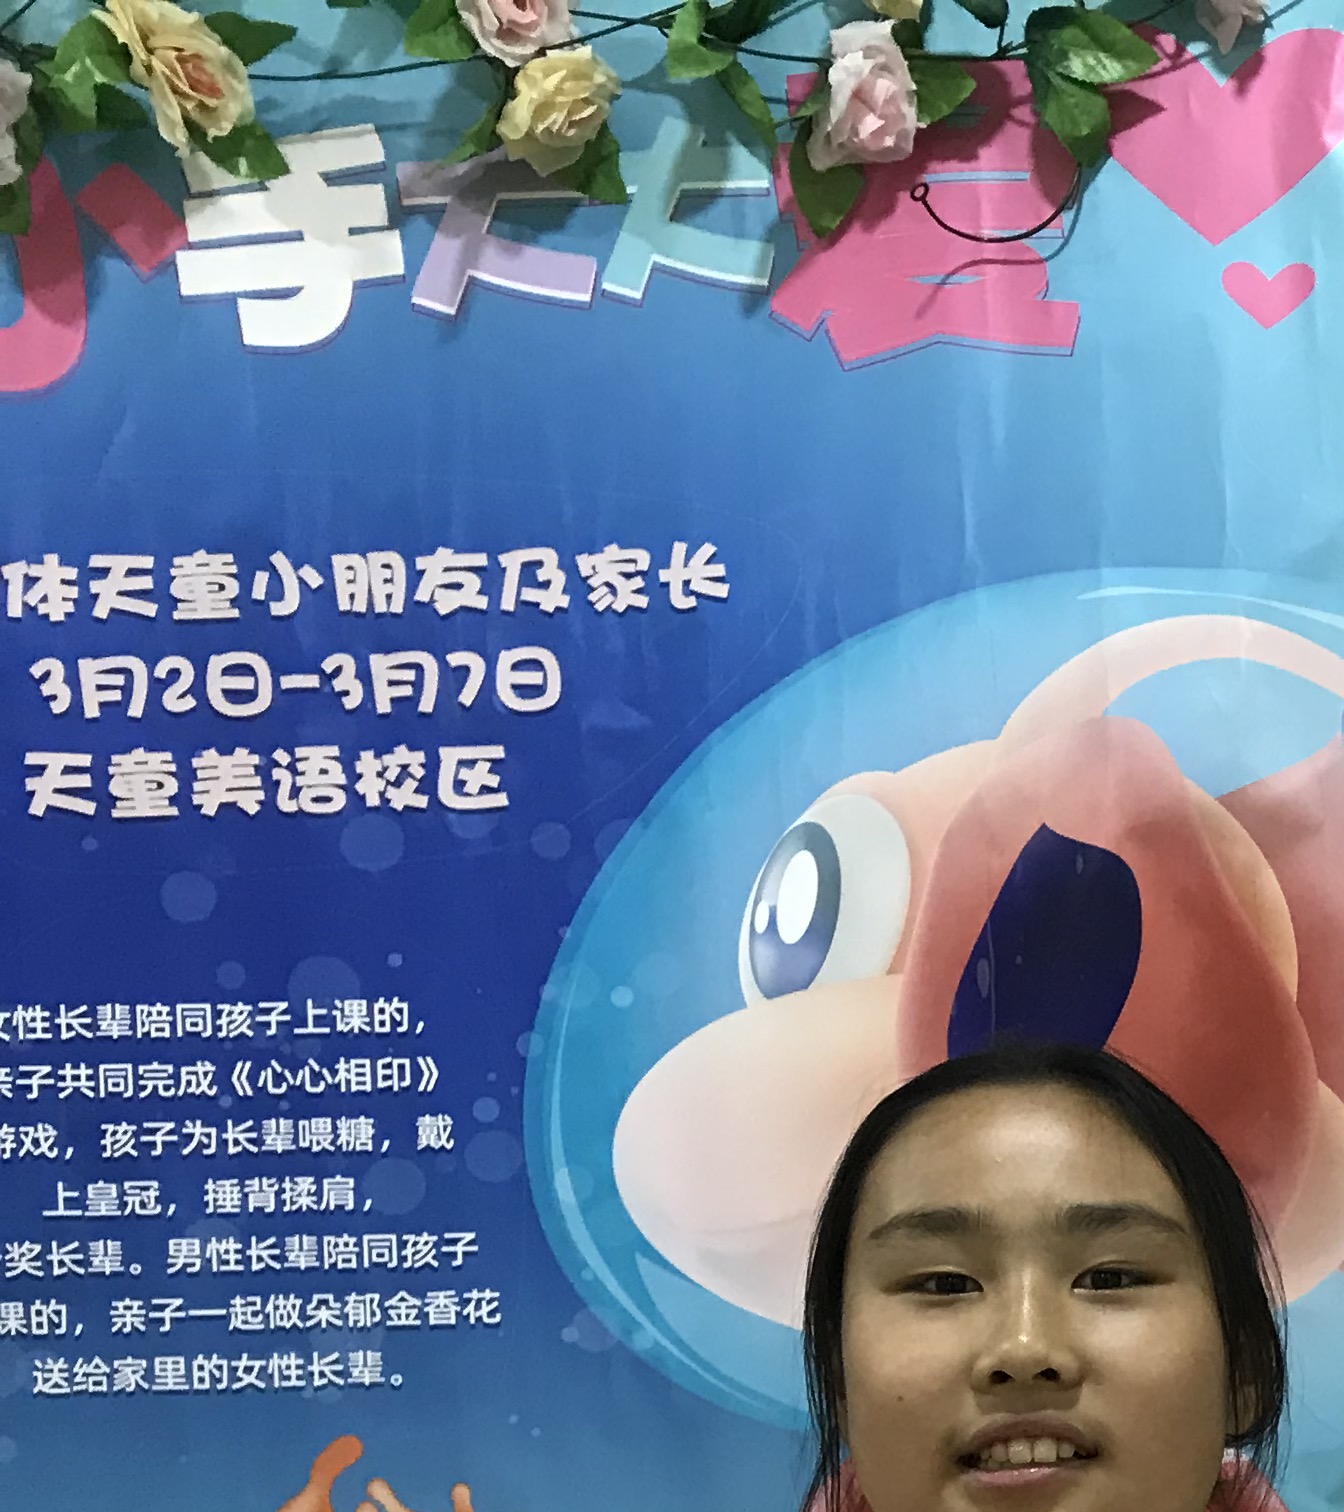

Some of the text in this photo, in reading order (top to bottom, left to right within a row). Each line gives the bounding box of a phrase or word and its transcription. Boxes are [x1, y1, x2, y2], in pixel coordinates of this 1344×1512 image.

[1, 540, 731, 623] 体天童小朋友及家长
[23, 744, 510, 820] 天童美语校区
[0, 997, 426, 1041] 性长辈陪同孩子上课的，
